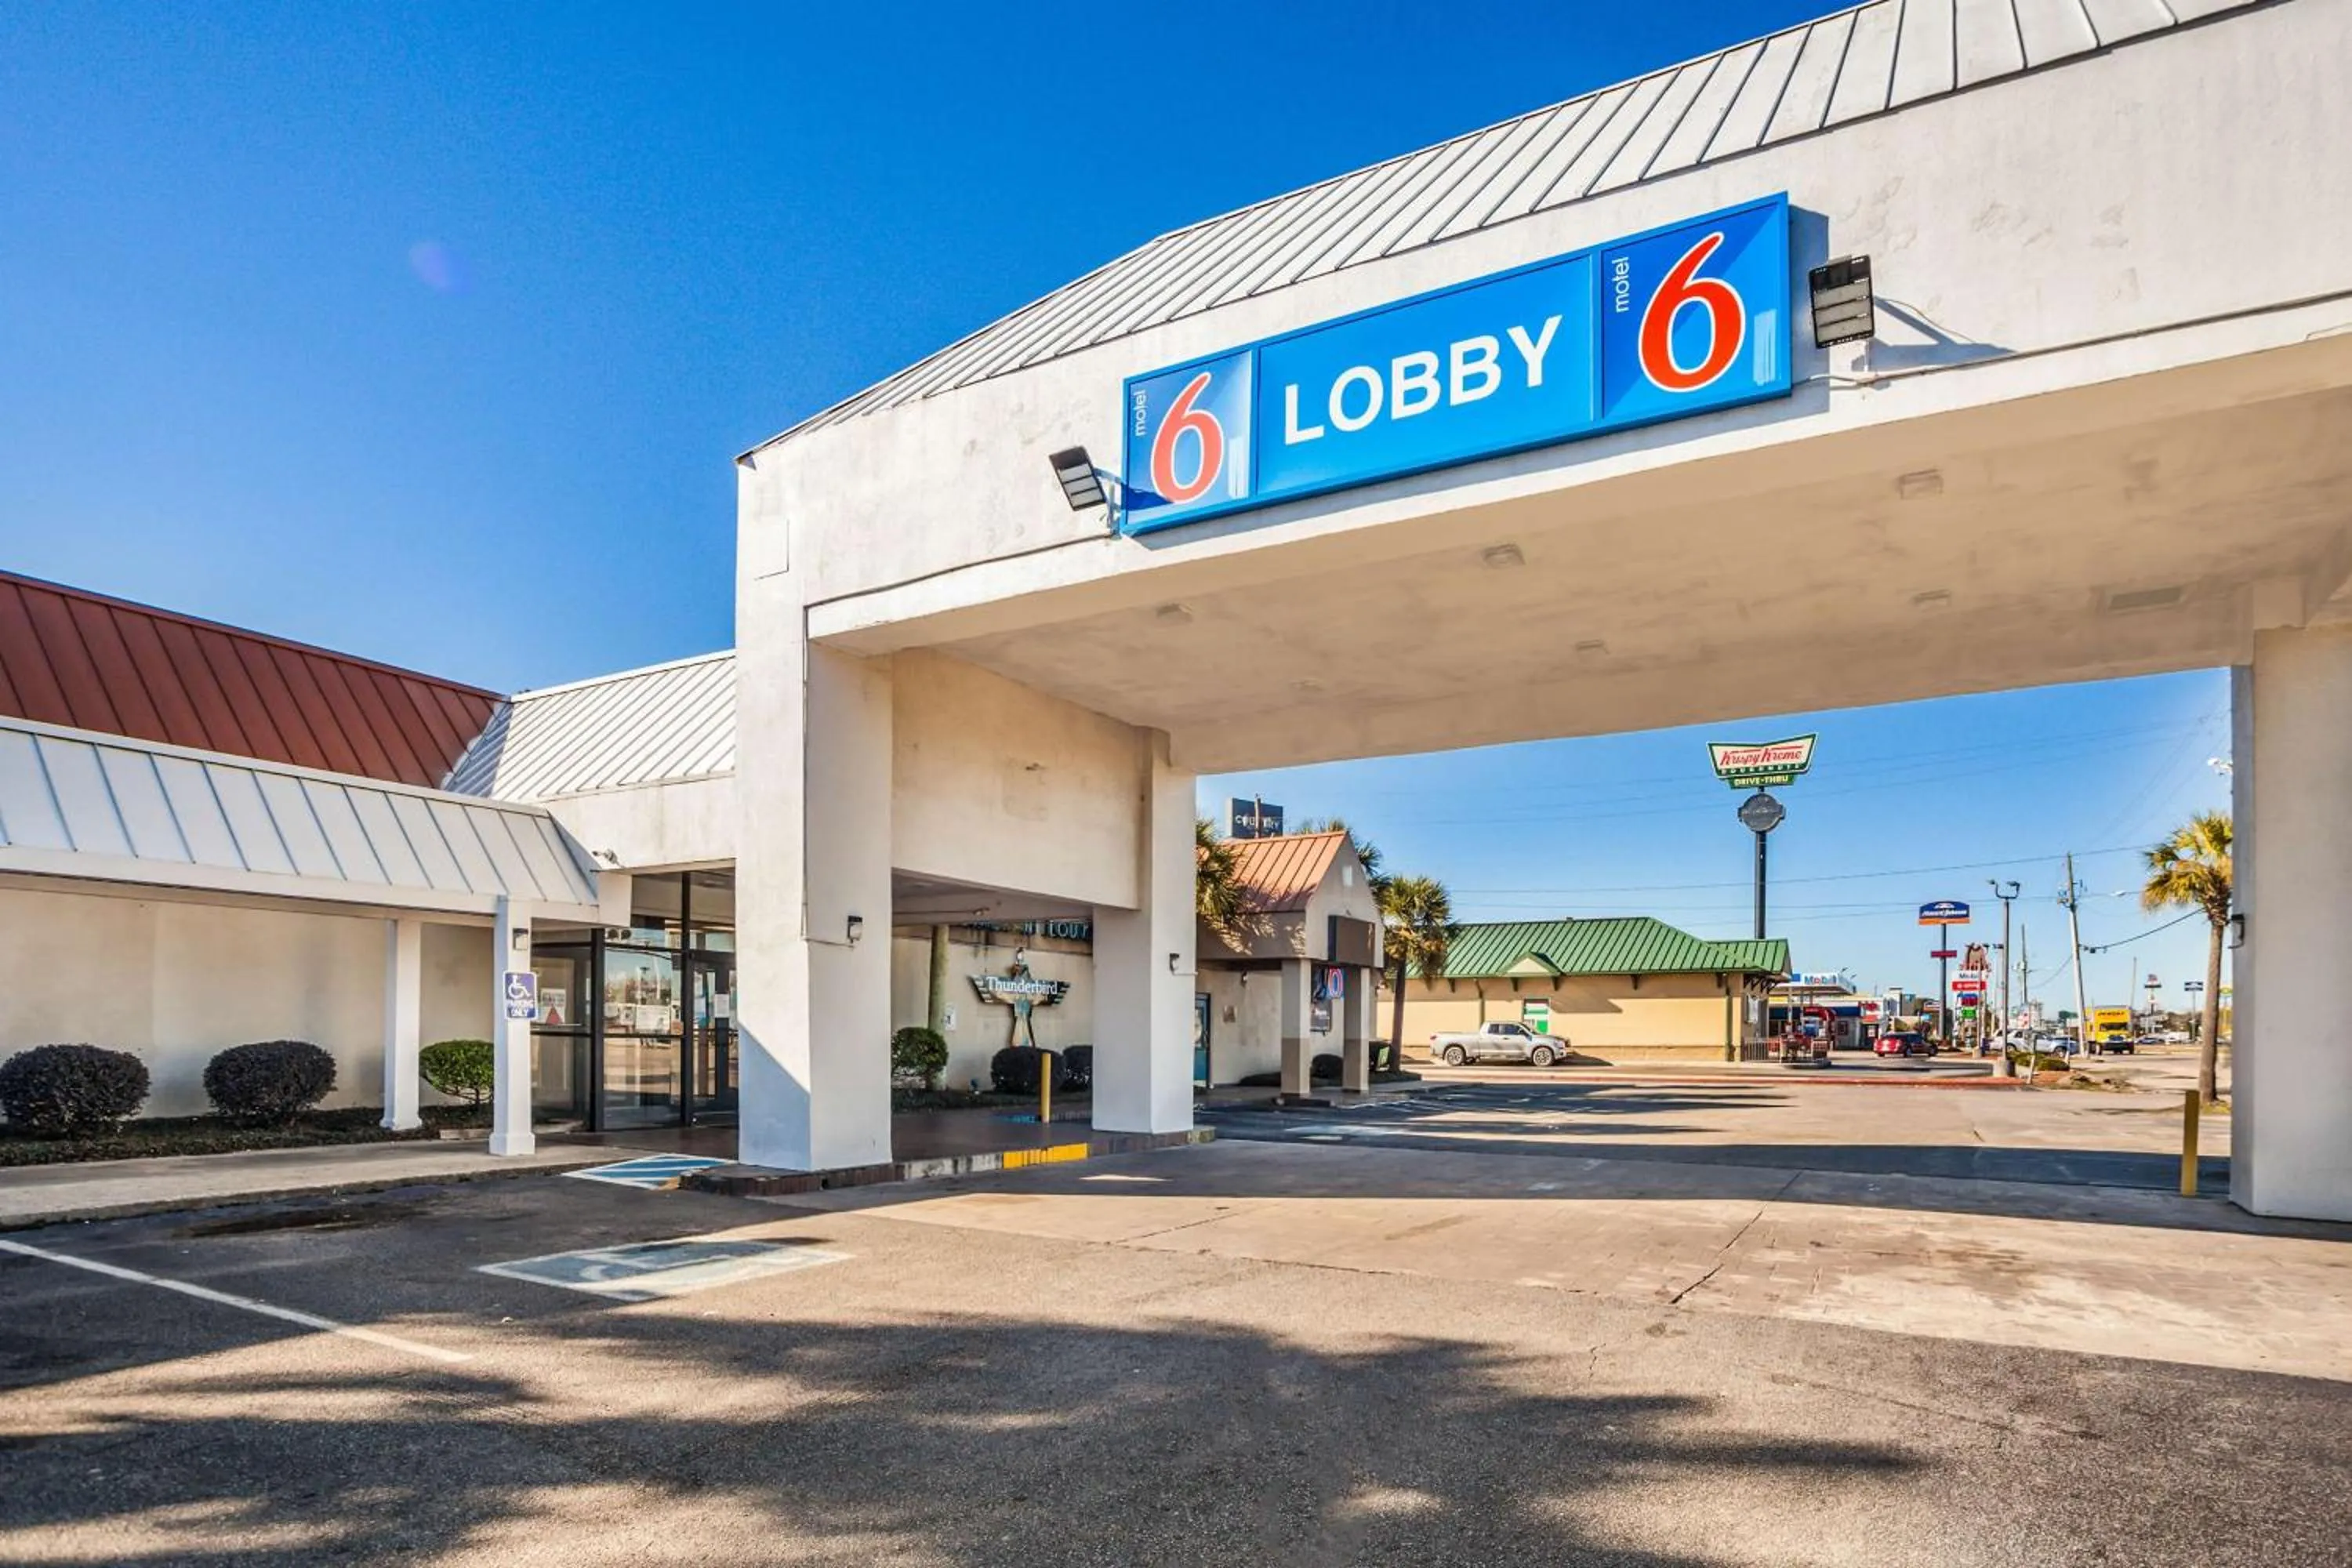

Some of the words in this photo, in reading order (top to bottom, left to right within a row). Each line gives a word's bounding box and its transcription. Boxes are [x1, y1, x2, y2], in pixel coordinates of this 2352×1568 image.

[1612, 256, 1630, 313] motel
[1638, 231, 1746, 392] 6
[1284, 314, 1563, 445] LOBBY
[1134, 389, 1147, 437] motel
[1150, 372, 1225, 504] 6
[1733, 775, 1789, 786] DRIVE-THRU
[985, 975, 1058, 995] Thunderbird
[1804, 975, 1837, 985] Mobil
